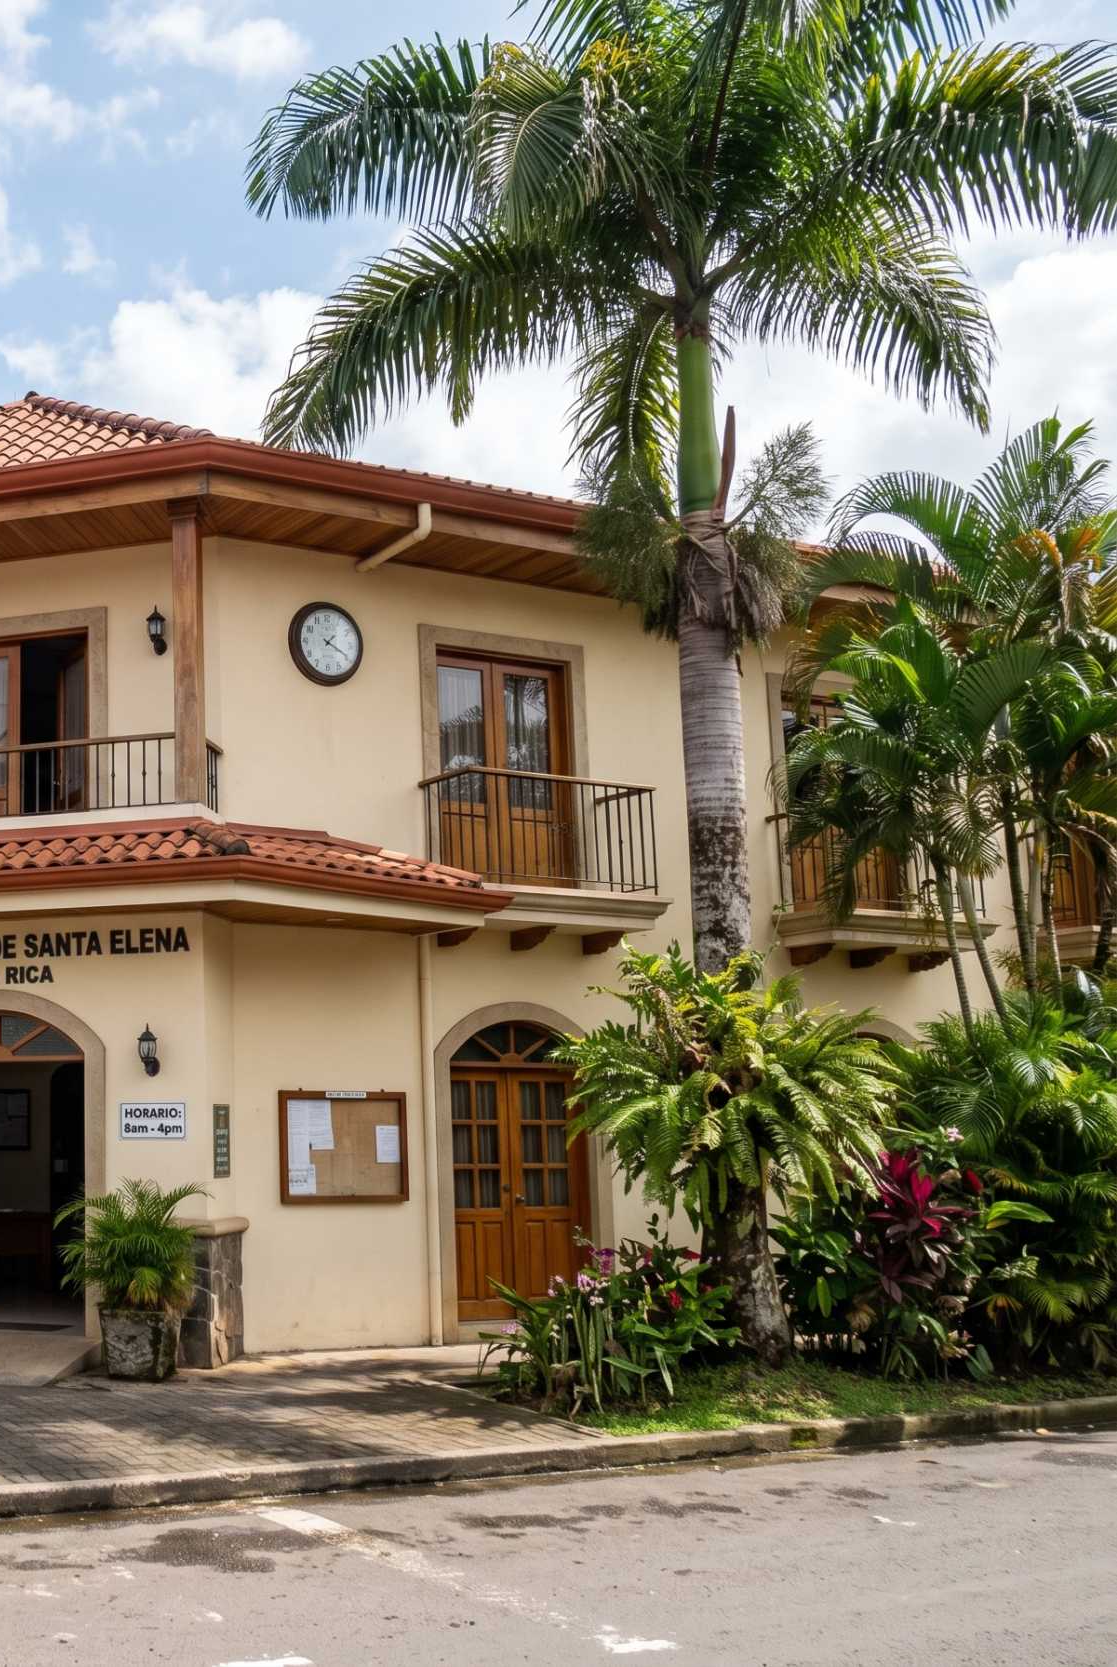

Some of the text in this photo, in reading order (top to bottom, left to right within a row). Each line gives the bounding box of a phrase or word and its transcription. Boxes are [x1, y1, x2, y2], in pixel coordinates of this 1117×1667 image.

[24, 931, 102, 958] SANTA
[110, 927, 190, 955] ELENA
[5, 965, 53, 984] RICA
[124, 1108, 182, 1118] HORARIO:
[124, 1123, 148, 1133] 8am
[157, 1123, 182, 1136] 4pm
